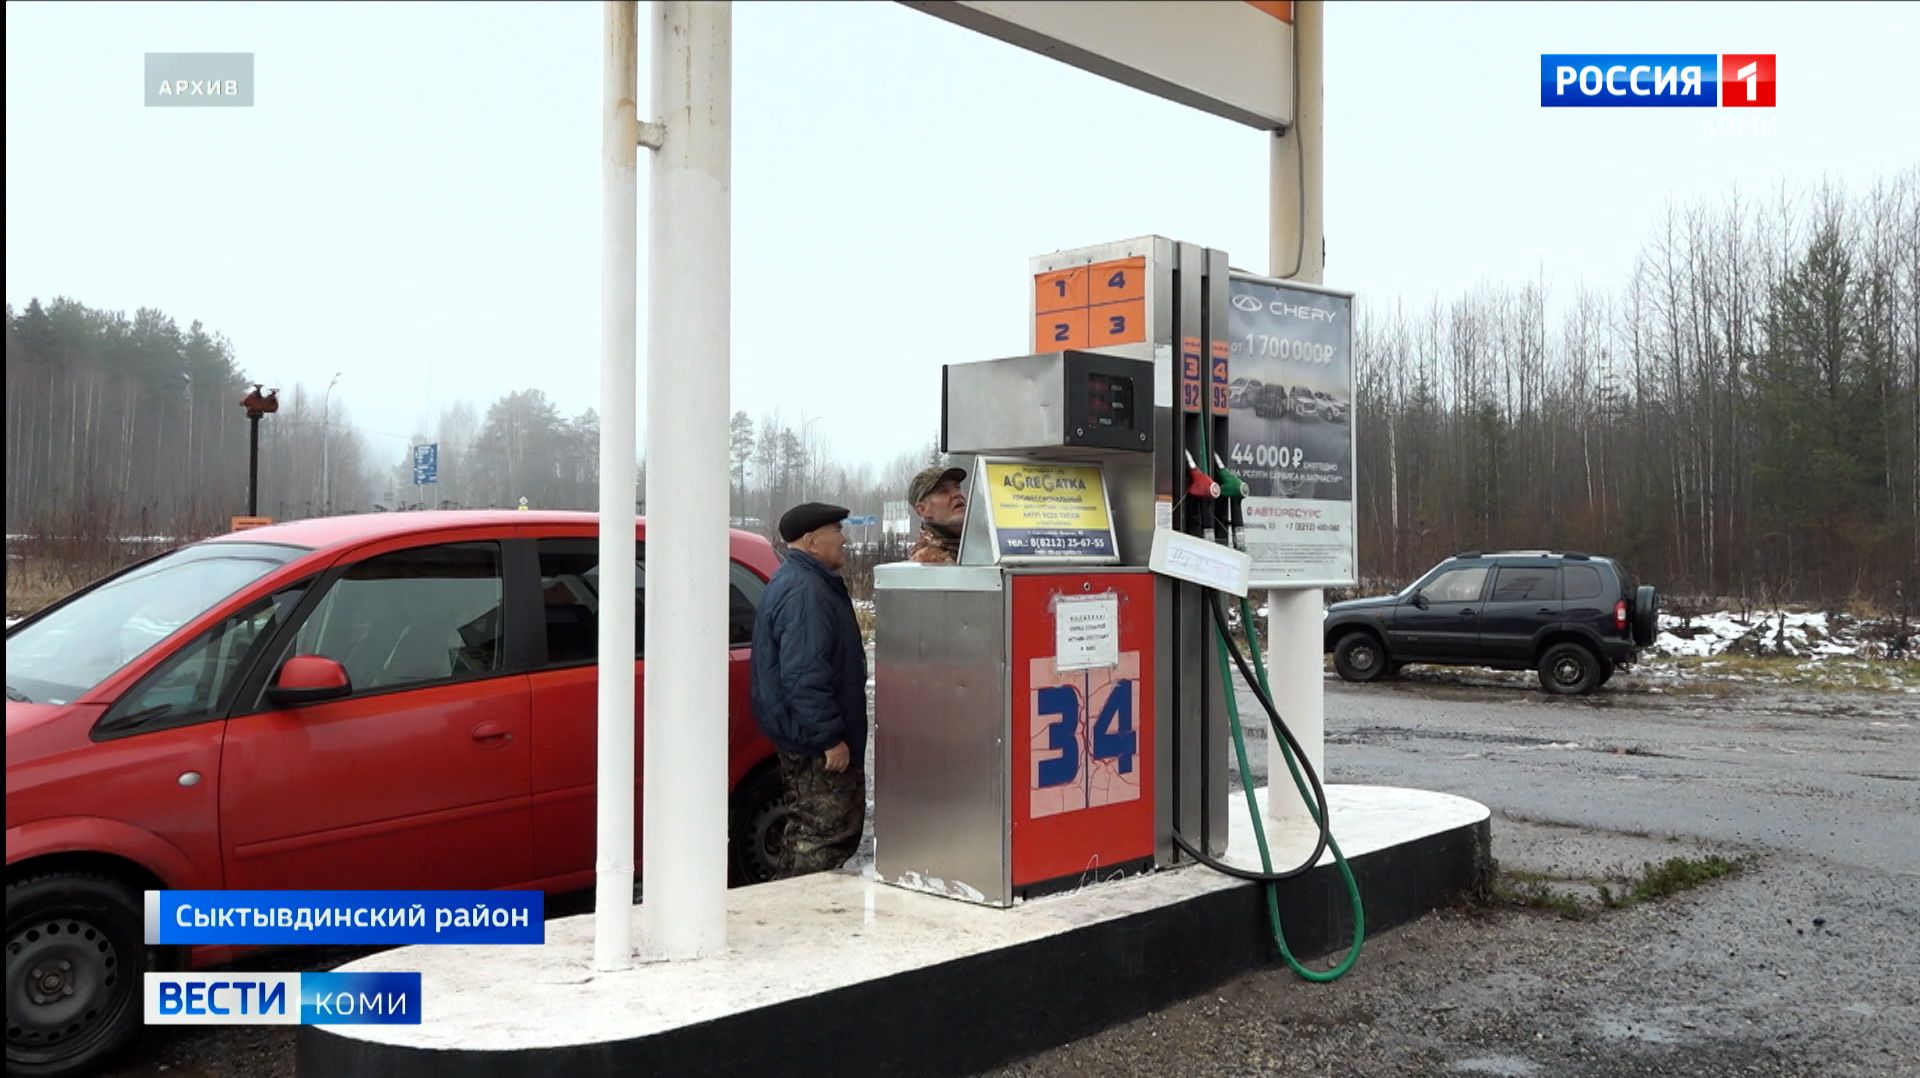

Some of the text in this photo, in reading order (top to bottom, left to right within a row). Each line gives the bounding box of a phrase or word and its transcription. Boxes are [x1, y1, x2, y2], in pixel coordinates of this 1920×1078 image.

[1055, 271, 1125, 297] 1 4
[1269, 301, 1337, 324] CHERY
[1054, 315, 1125, 341] 2 3
[1185, 358, 1198, 377] 3
[1213, 362, 1227, 381] 4
[1184, 383, 1199, 407] 92
[1213, 386, 1227, 409] 95
[1038, 678, 1137, 789] 3 4
